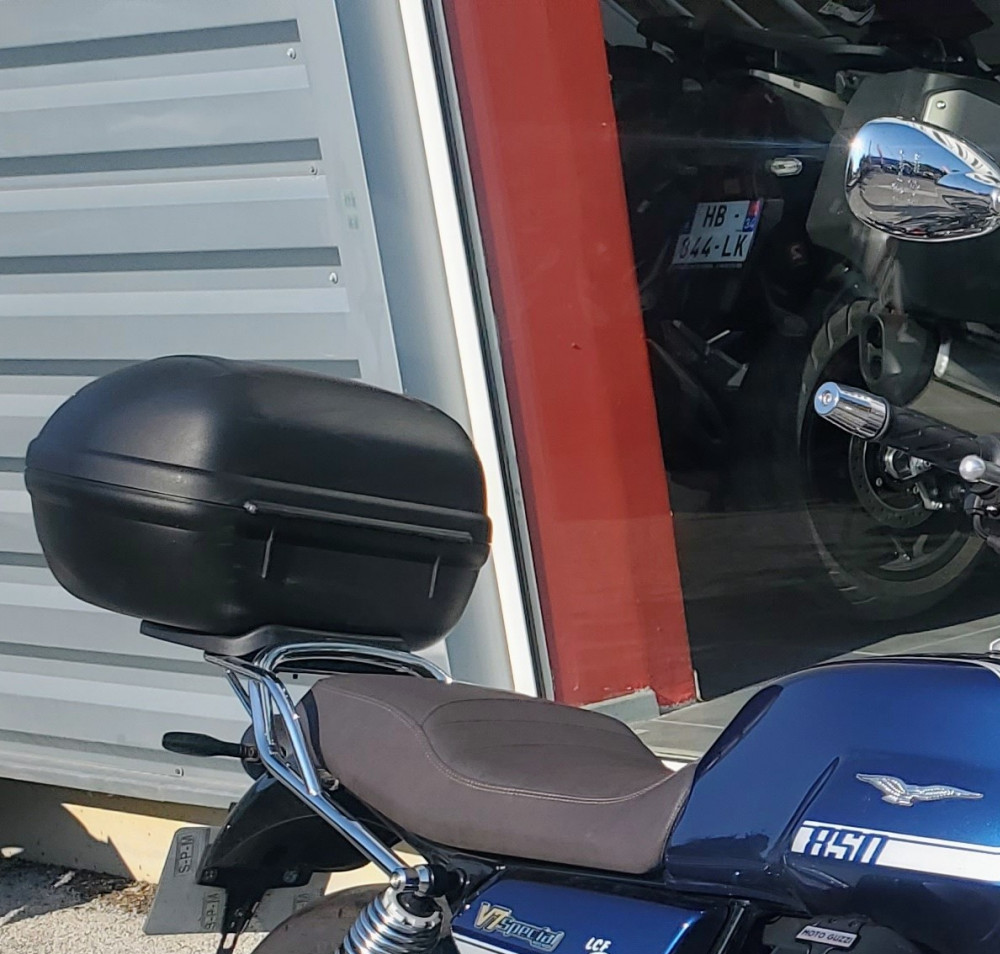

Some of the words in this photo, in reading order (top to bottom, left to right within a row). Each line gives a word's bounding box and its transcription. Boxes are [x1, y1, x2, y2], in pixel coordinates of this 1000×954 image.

[802, 825, 889, 865] 850
[475, 902, 512, 931] V7
[802, 929, 826, 939] MOTO
[827, 933, 853, 944] GUZZI
